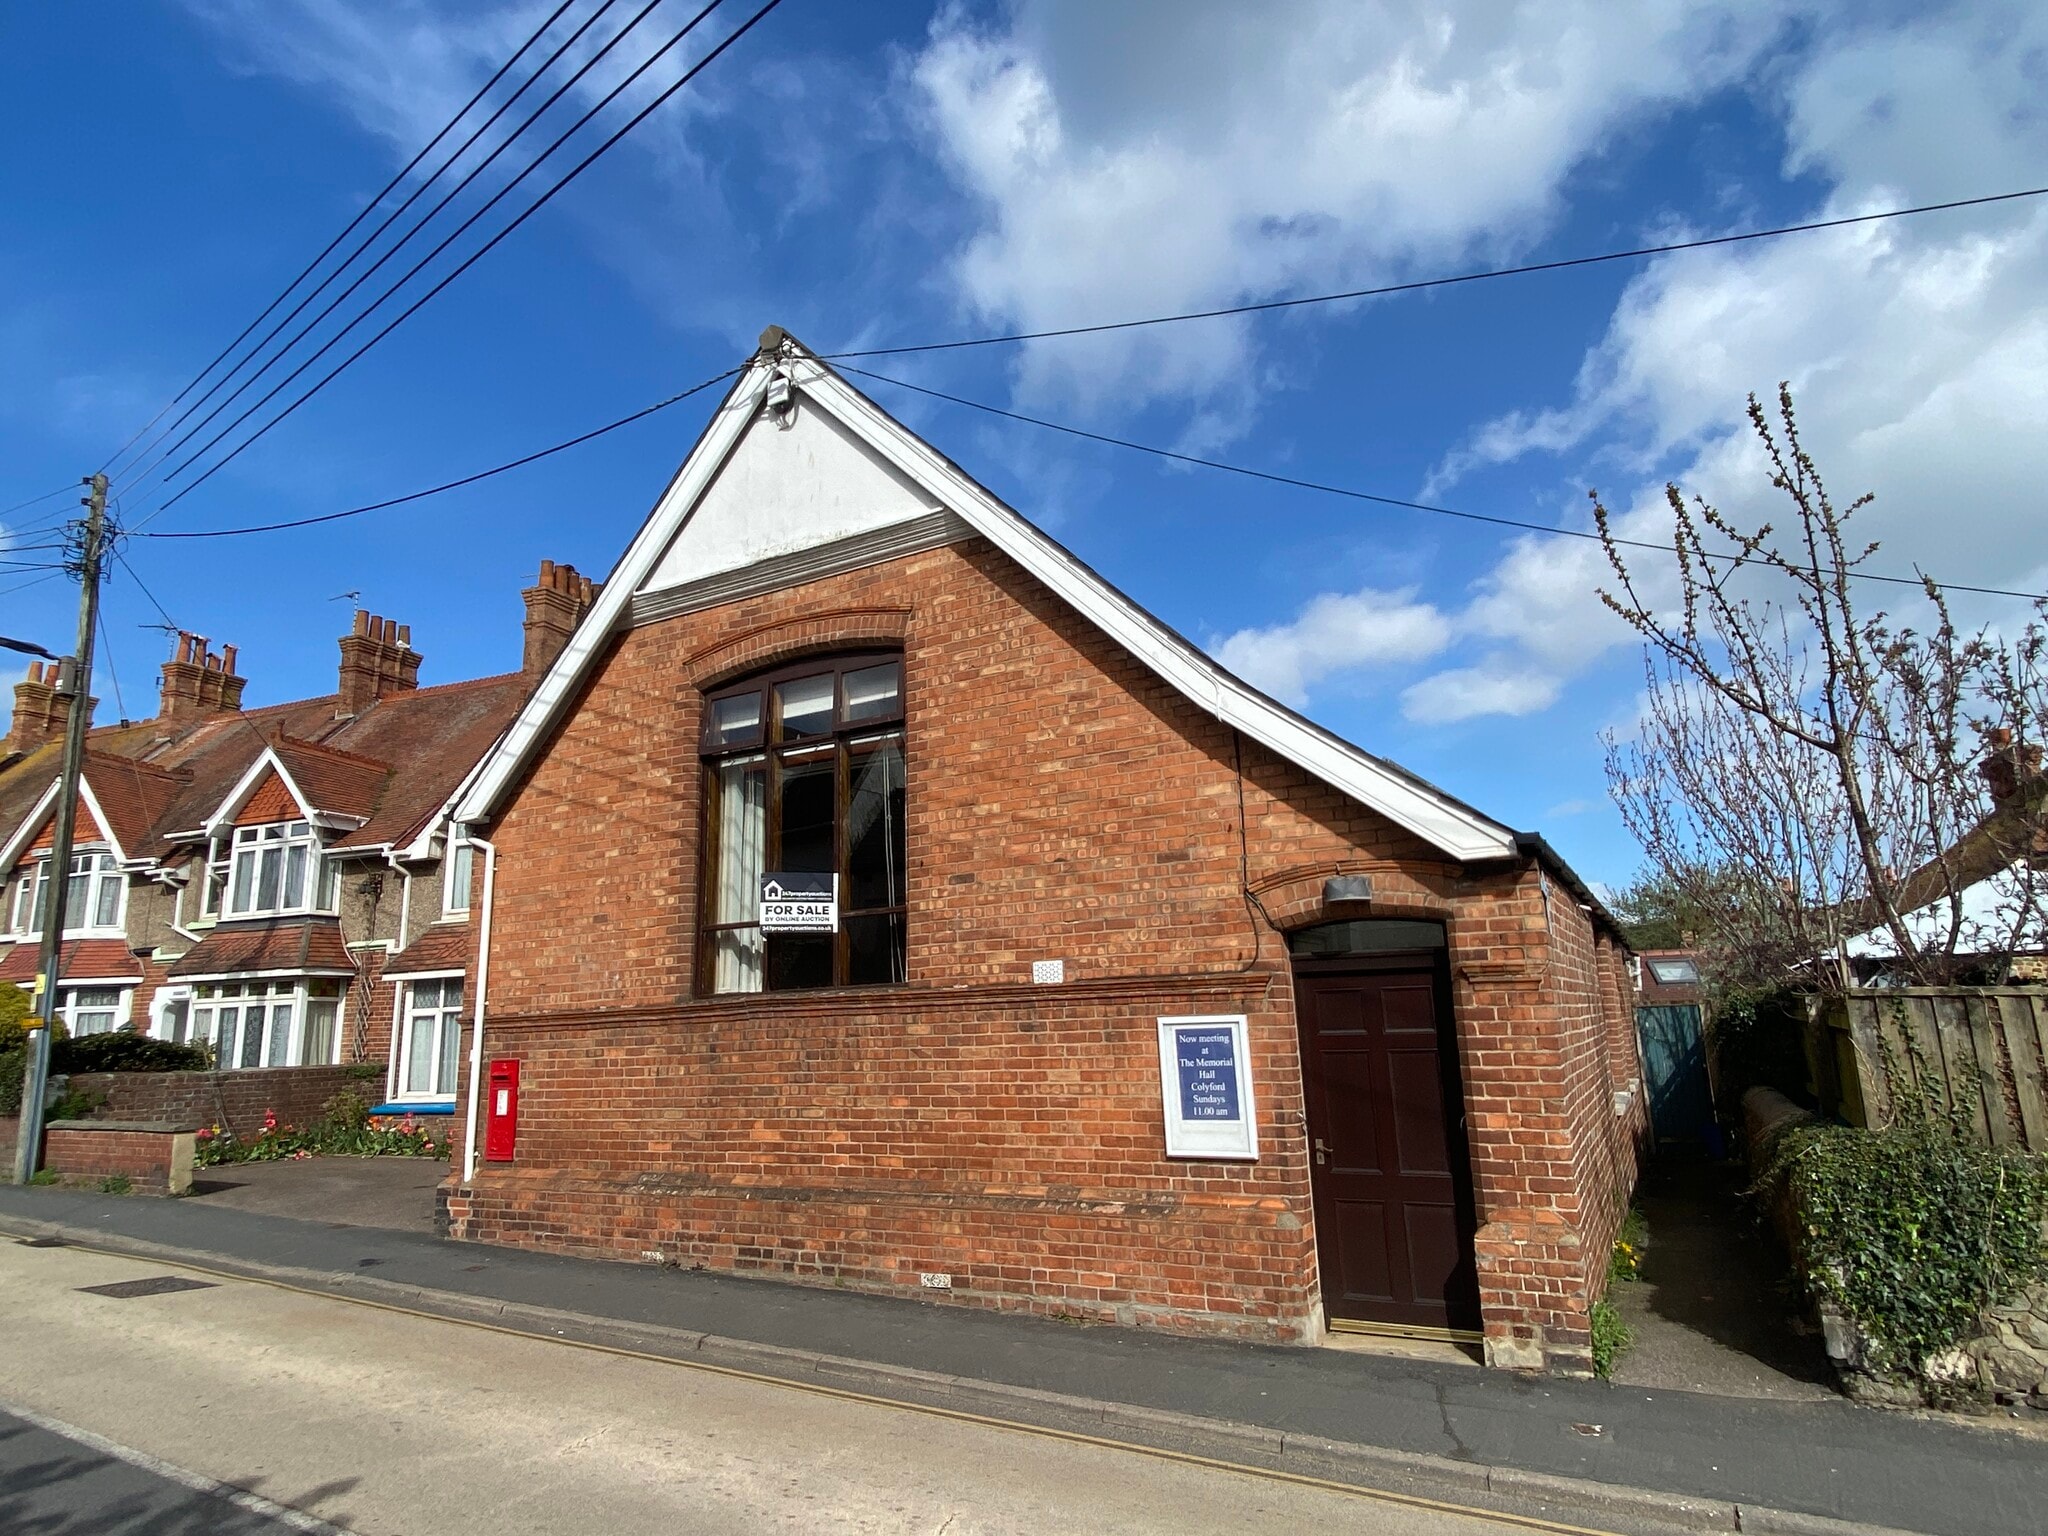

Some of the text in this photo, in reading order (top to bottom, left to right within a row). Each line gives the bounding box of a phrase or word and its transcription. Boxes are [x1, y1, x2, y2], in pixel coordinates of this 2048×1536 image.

[765, 905, 830, 915] FOR SALE
[1179, 1034, 1230, 1044] Now meeting
[1179, 1058, 1233, 1067] The Memorial
[1199, 1070, 1215, 1079] Hall
[1191, 1082, 1226, 1093] Colyford
[1192, 1094, 1226, 1105] Sundays
[1193, 1107, 1215, 1116] 11.00
